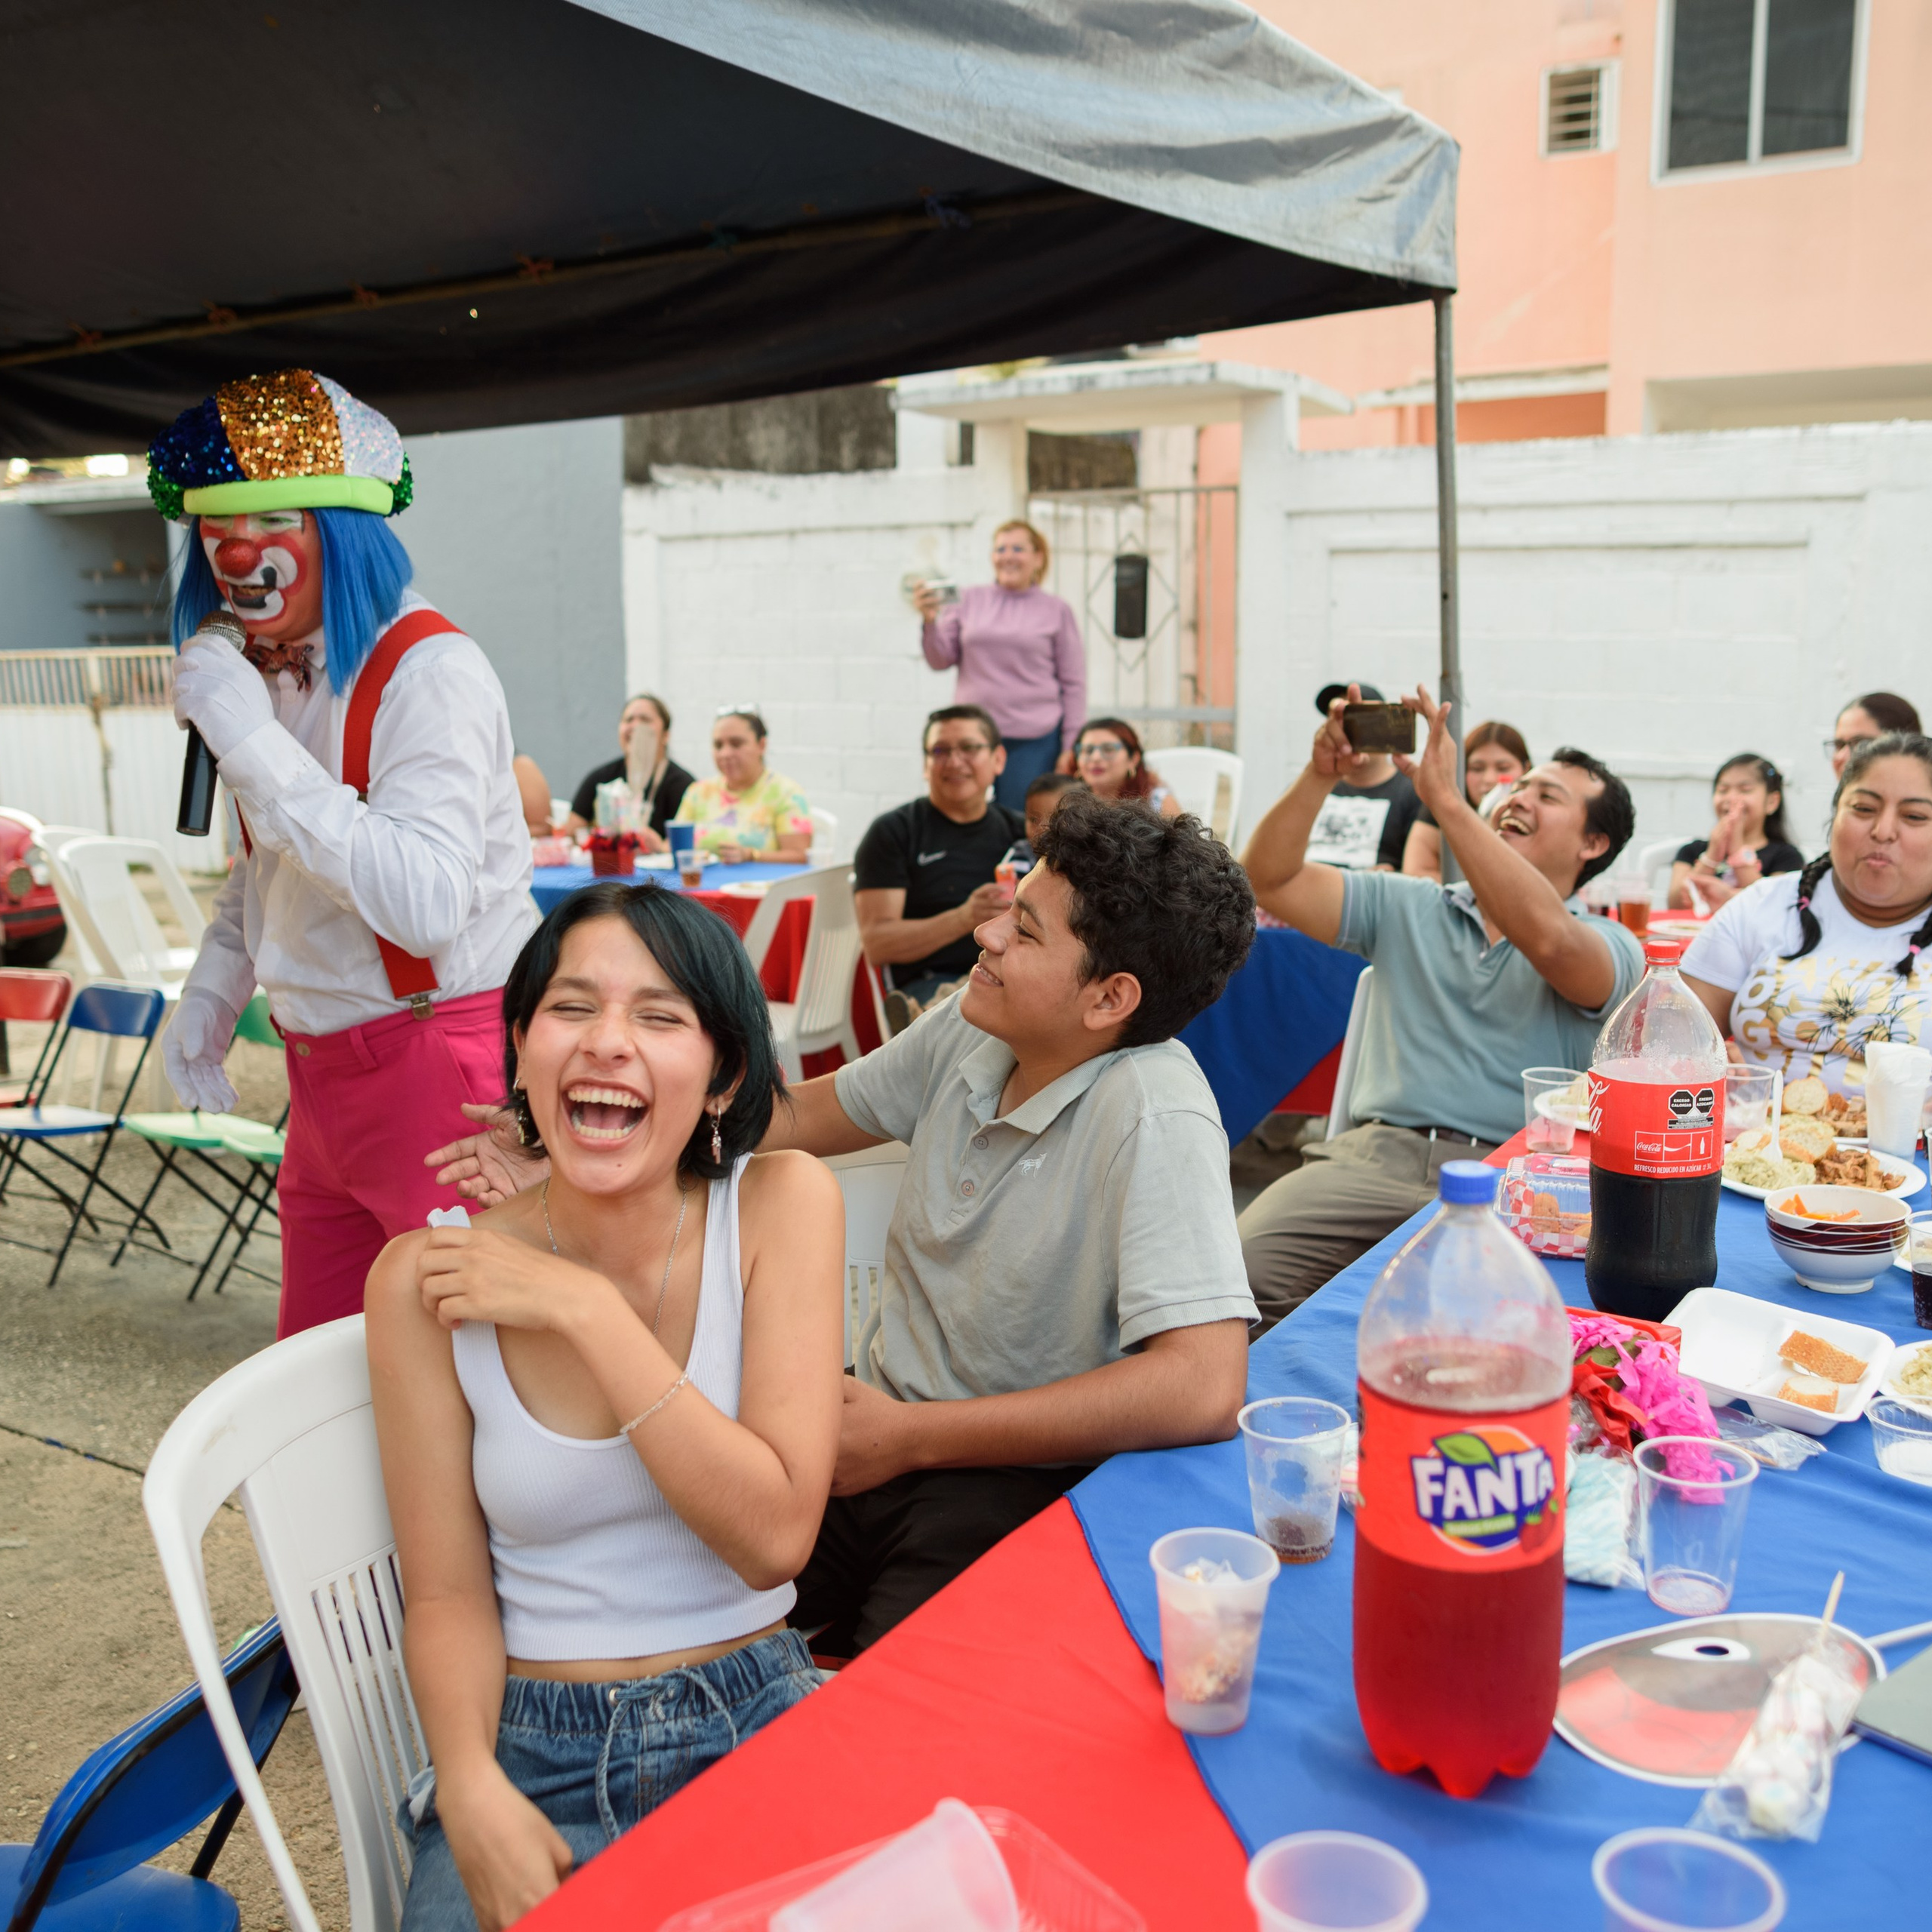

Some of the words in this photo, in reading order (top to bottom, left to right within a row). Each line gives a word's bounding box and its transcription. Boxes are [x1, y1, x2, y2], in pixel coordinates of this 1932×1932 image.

[1846, 980, 1932, 1014] TH
[1634, 1164, 1656, 1174] REFRESCO
[1685, 1164, 1702, 1172] AZÚCAR
[1411, 1447, 1555, 1519] FANTA
